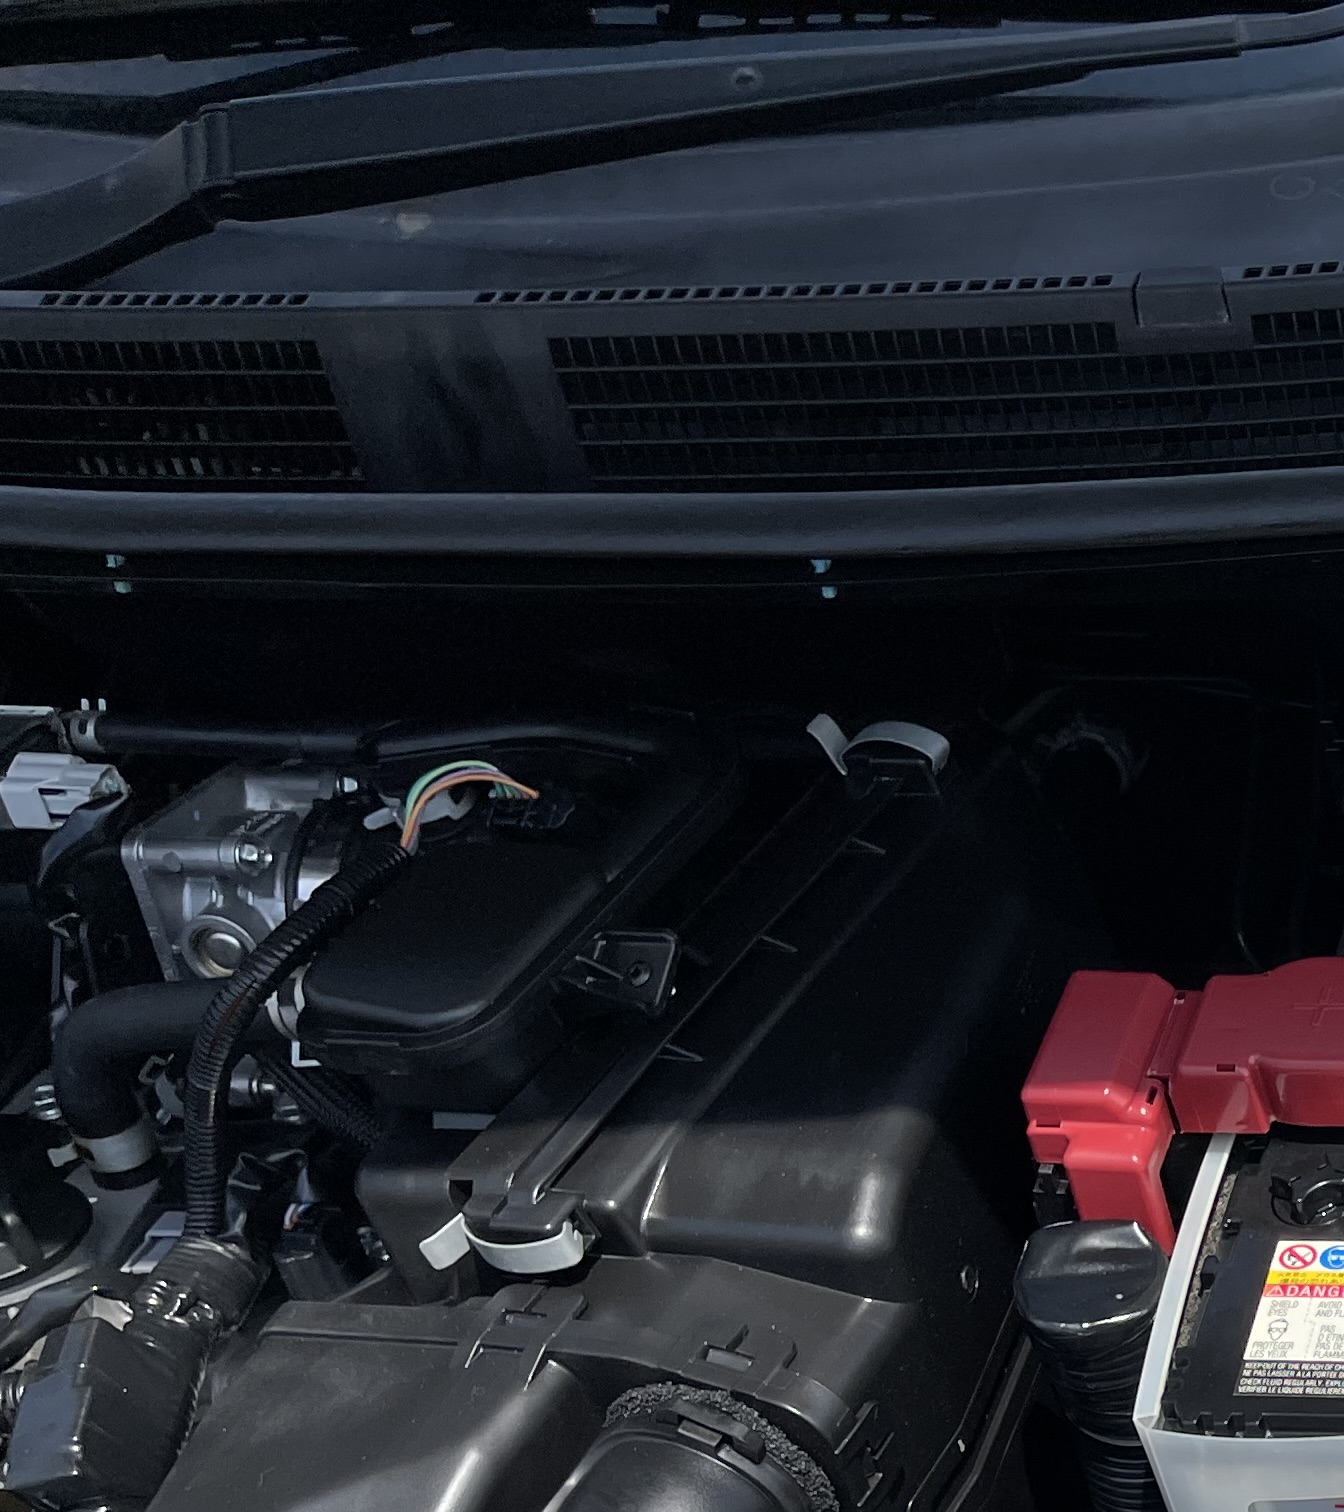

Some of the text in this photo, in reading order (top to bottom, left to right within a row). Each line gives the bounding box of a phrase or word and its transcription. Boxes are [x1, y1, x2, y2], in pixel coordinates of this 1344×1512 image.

[1271, 1300, 1299, 1308] SHIELD
[1317, 1301, 1342, 1309] AVOID
[1315, 1310, 1333, 1318] AND
[1250, 1350, 1265, 1358] LES
